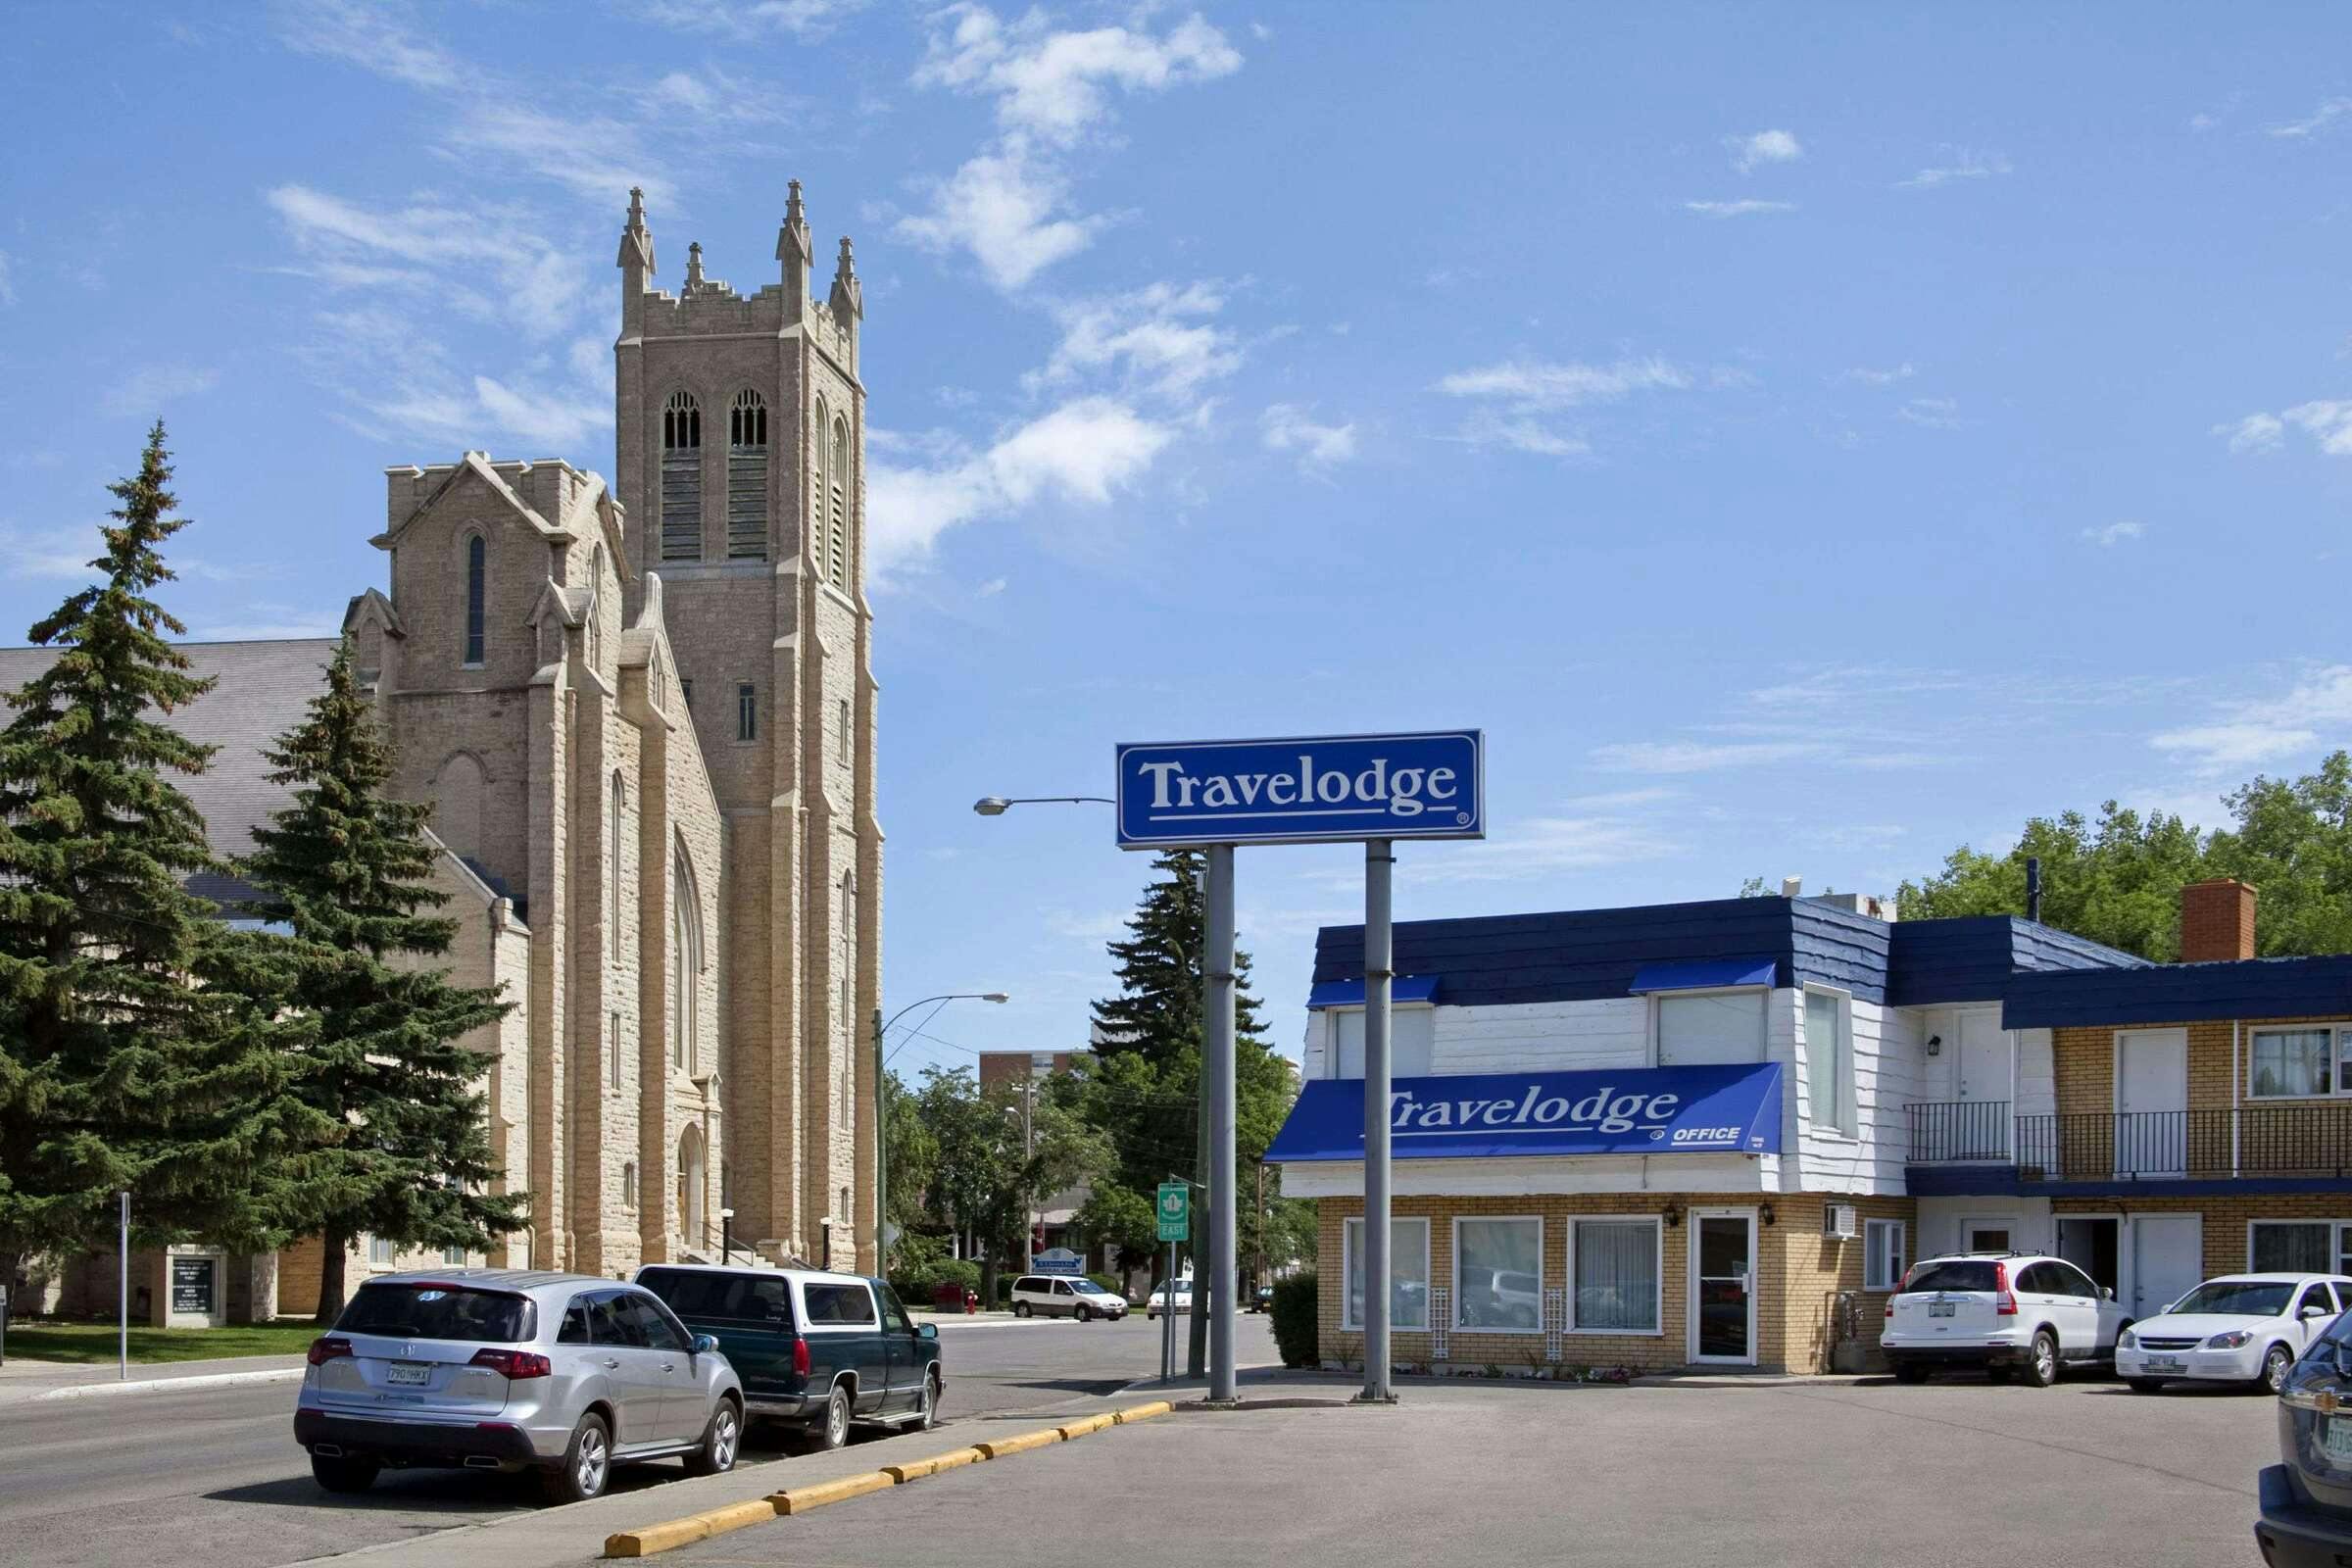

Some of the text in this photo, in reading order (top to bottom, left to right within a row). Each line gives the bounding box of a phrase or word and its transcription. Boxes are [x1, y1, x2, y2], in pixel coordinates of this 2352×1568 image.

[1138, 755, 1457, 816] Travelodge
[1390, 1085, 1679, 1134] Travelodge
[1673, 1127, 1741, 1141] OFFICE
[1162, 1225, 1184, 1235] EAST
